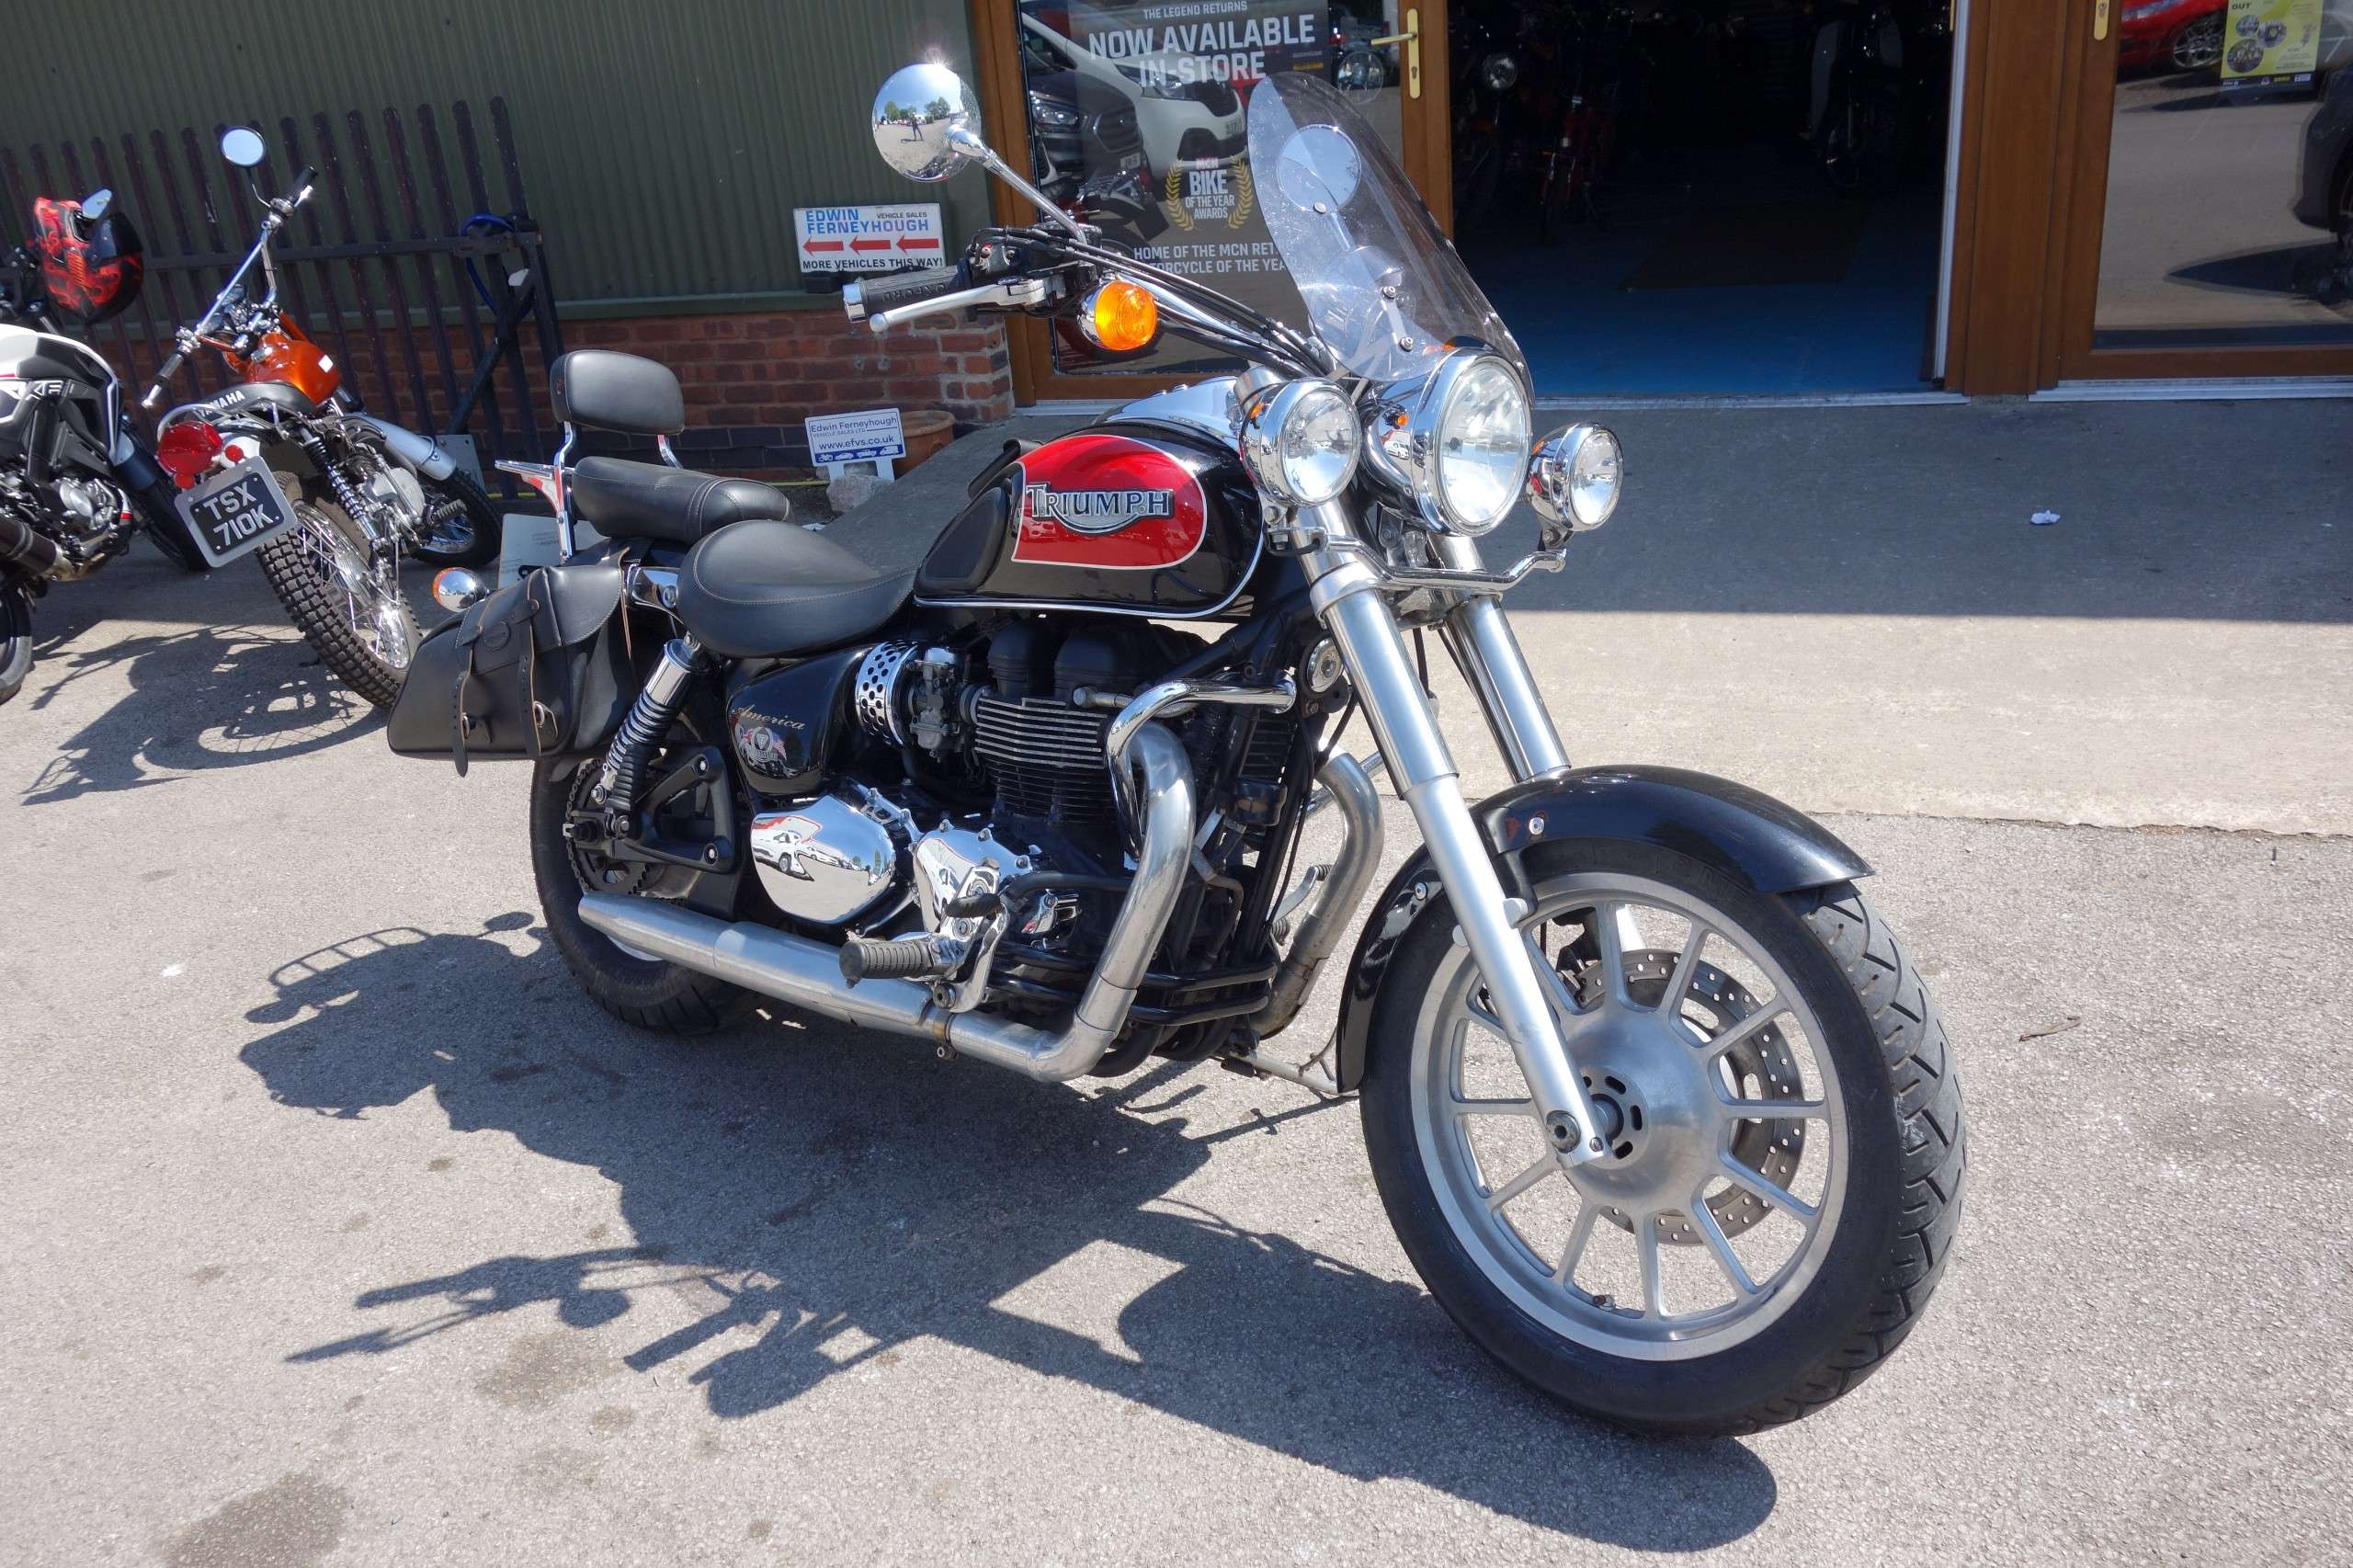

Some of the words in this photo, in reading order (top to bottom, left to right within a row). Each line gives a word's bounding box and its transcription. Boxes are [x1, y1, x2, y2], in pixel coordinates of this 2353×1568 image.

[1143, 8, 1162, 19] THE
[1164, 5, 1201, 17] LEGEND
[1203, 1, 1248, 15] RETURNS
[1088, 28, 1154, 60] NOW
[1163, 14, 1316, 53] AVAILABLE
[1139, 51, 1267, 87] IN-STORE
[1189, 169, 1229, 196] BIKE
[1186, 196, 1195, 208] OF
[1197, 195, 1212, 207] THE
[1213, 194, 1235, 207] YEAR
[805, 209, 859, 222] EDWIN
[1194, 207, 1229, 220] AWARDS
[807, 219, 929, 234] FERNEYHOUGH
[1133, 245, 1170, 260] HOME
[1173, 245, 1189, 258] OF
[1192, 244, 1216, 258] THE
[1219, 243, 1248, 256] MCN
[1251, 242, 1278, 256] RET
[802, 259, 832, 270] MORE
[834, 258, 886, 269] VEHICLES
[888, 258, 914, 268] THIS
[915, 257, 943, 267] WAY!
[1149, 260, 1214, 275] ORCYCLE
[1216, 259, 1233, 273] OF
[1234, 258, 1259, 273] THE
[1262, 257, 1288, 272] YEA
[811, 424, 837, 433] Edwin
[839, 416, 897, 429] Ferneyhough
[818, 435, 894, 450] www.efvs.co.uk
[202, 481, 257, 520] TSX
[1026, 483, 1171, 517] TRIUMPH
[212, 504, 274, 547] 710K
[732, 704, 806, 730] America
